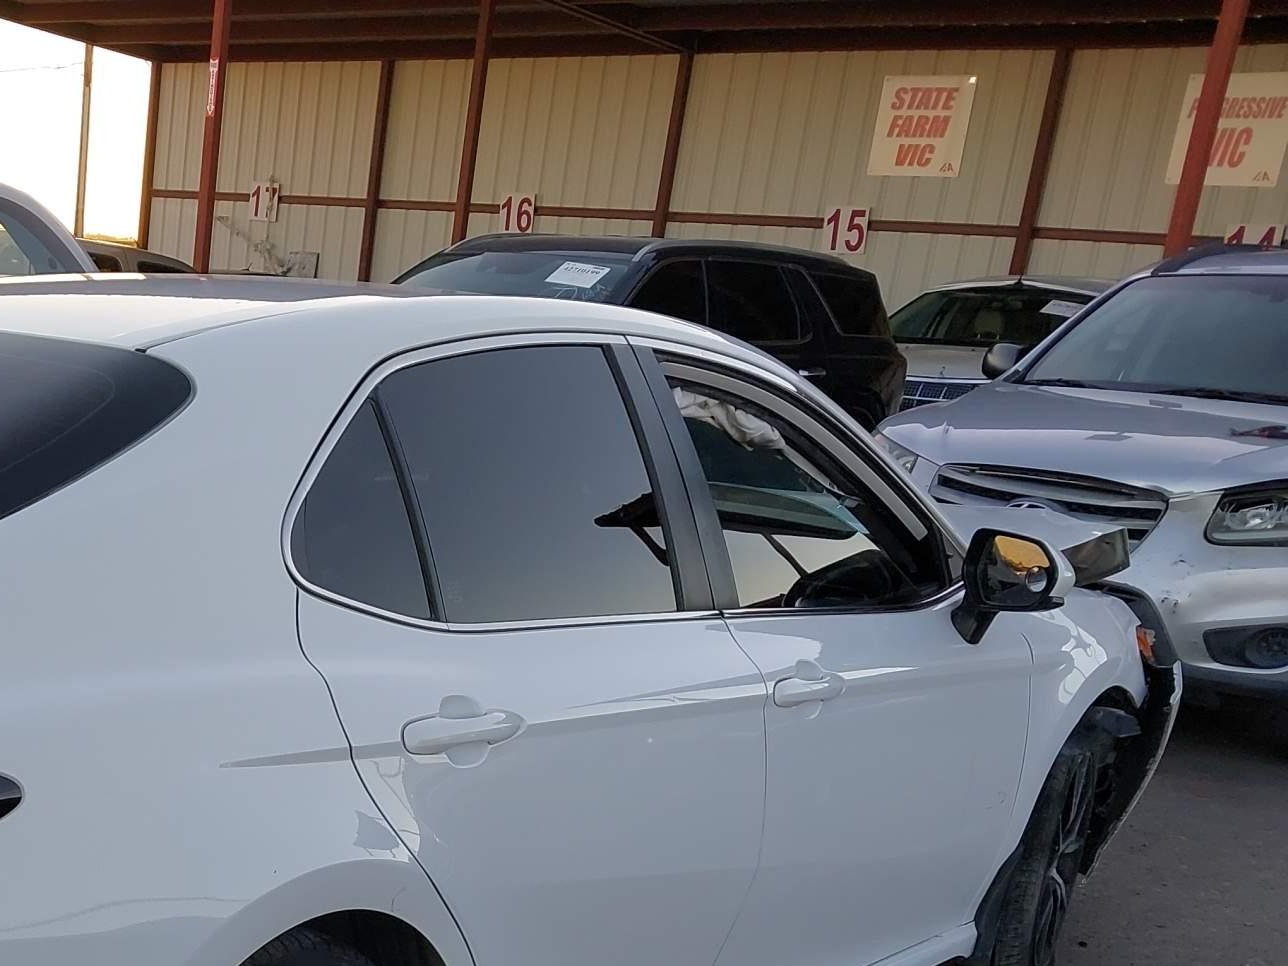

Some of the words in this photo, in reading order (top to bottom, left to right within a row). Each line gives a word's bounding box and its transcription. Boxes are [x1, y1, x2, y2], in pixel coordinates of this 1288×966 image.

[891, 87, 960, 110] STATE
[1188, 96, 1288, 118] PGRESSIVE
[887, 115, 952, 138] FARM
[894, 143, 936, 168] VIC
[252, 185, 278, 218] 17
[502, 195, 532, 232] 16
[827, 208, 866, 252] 15
